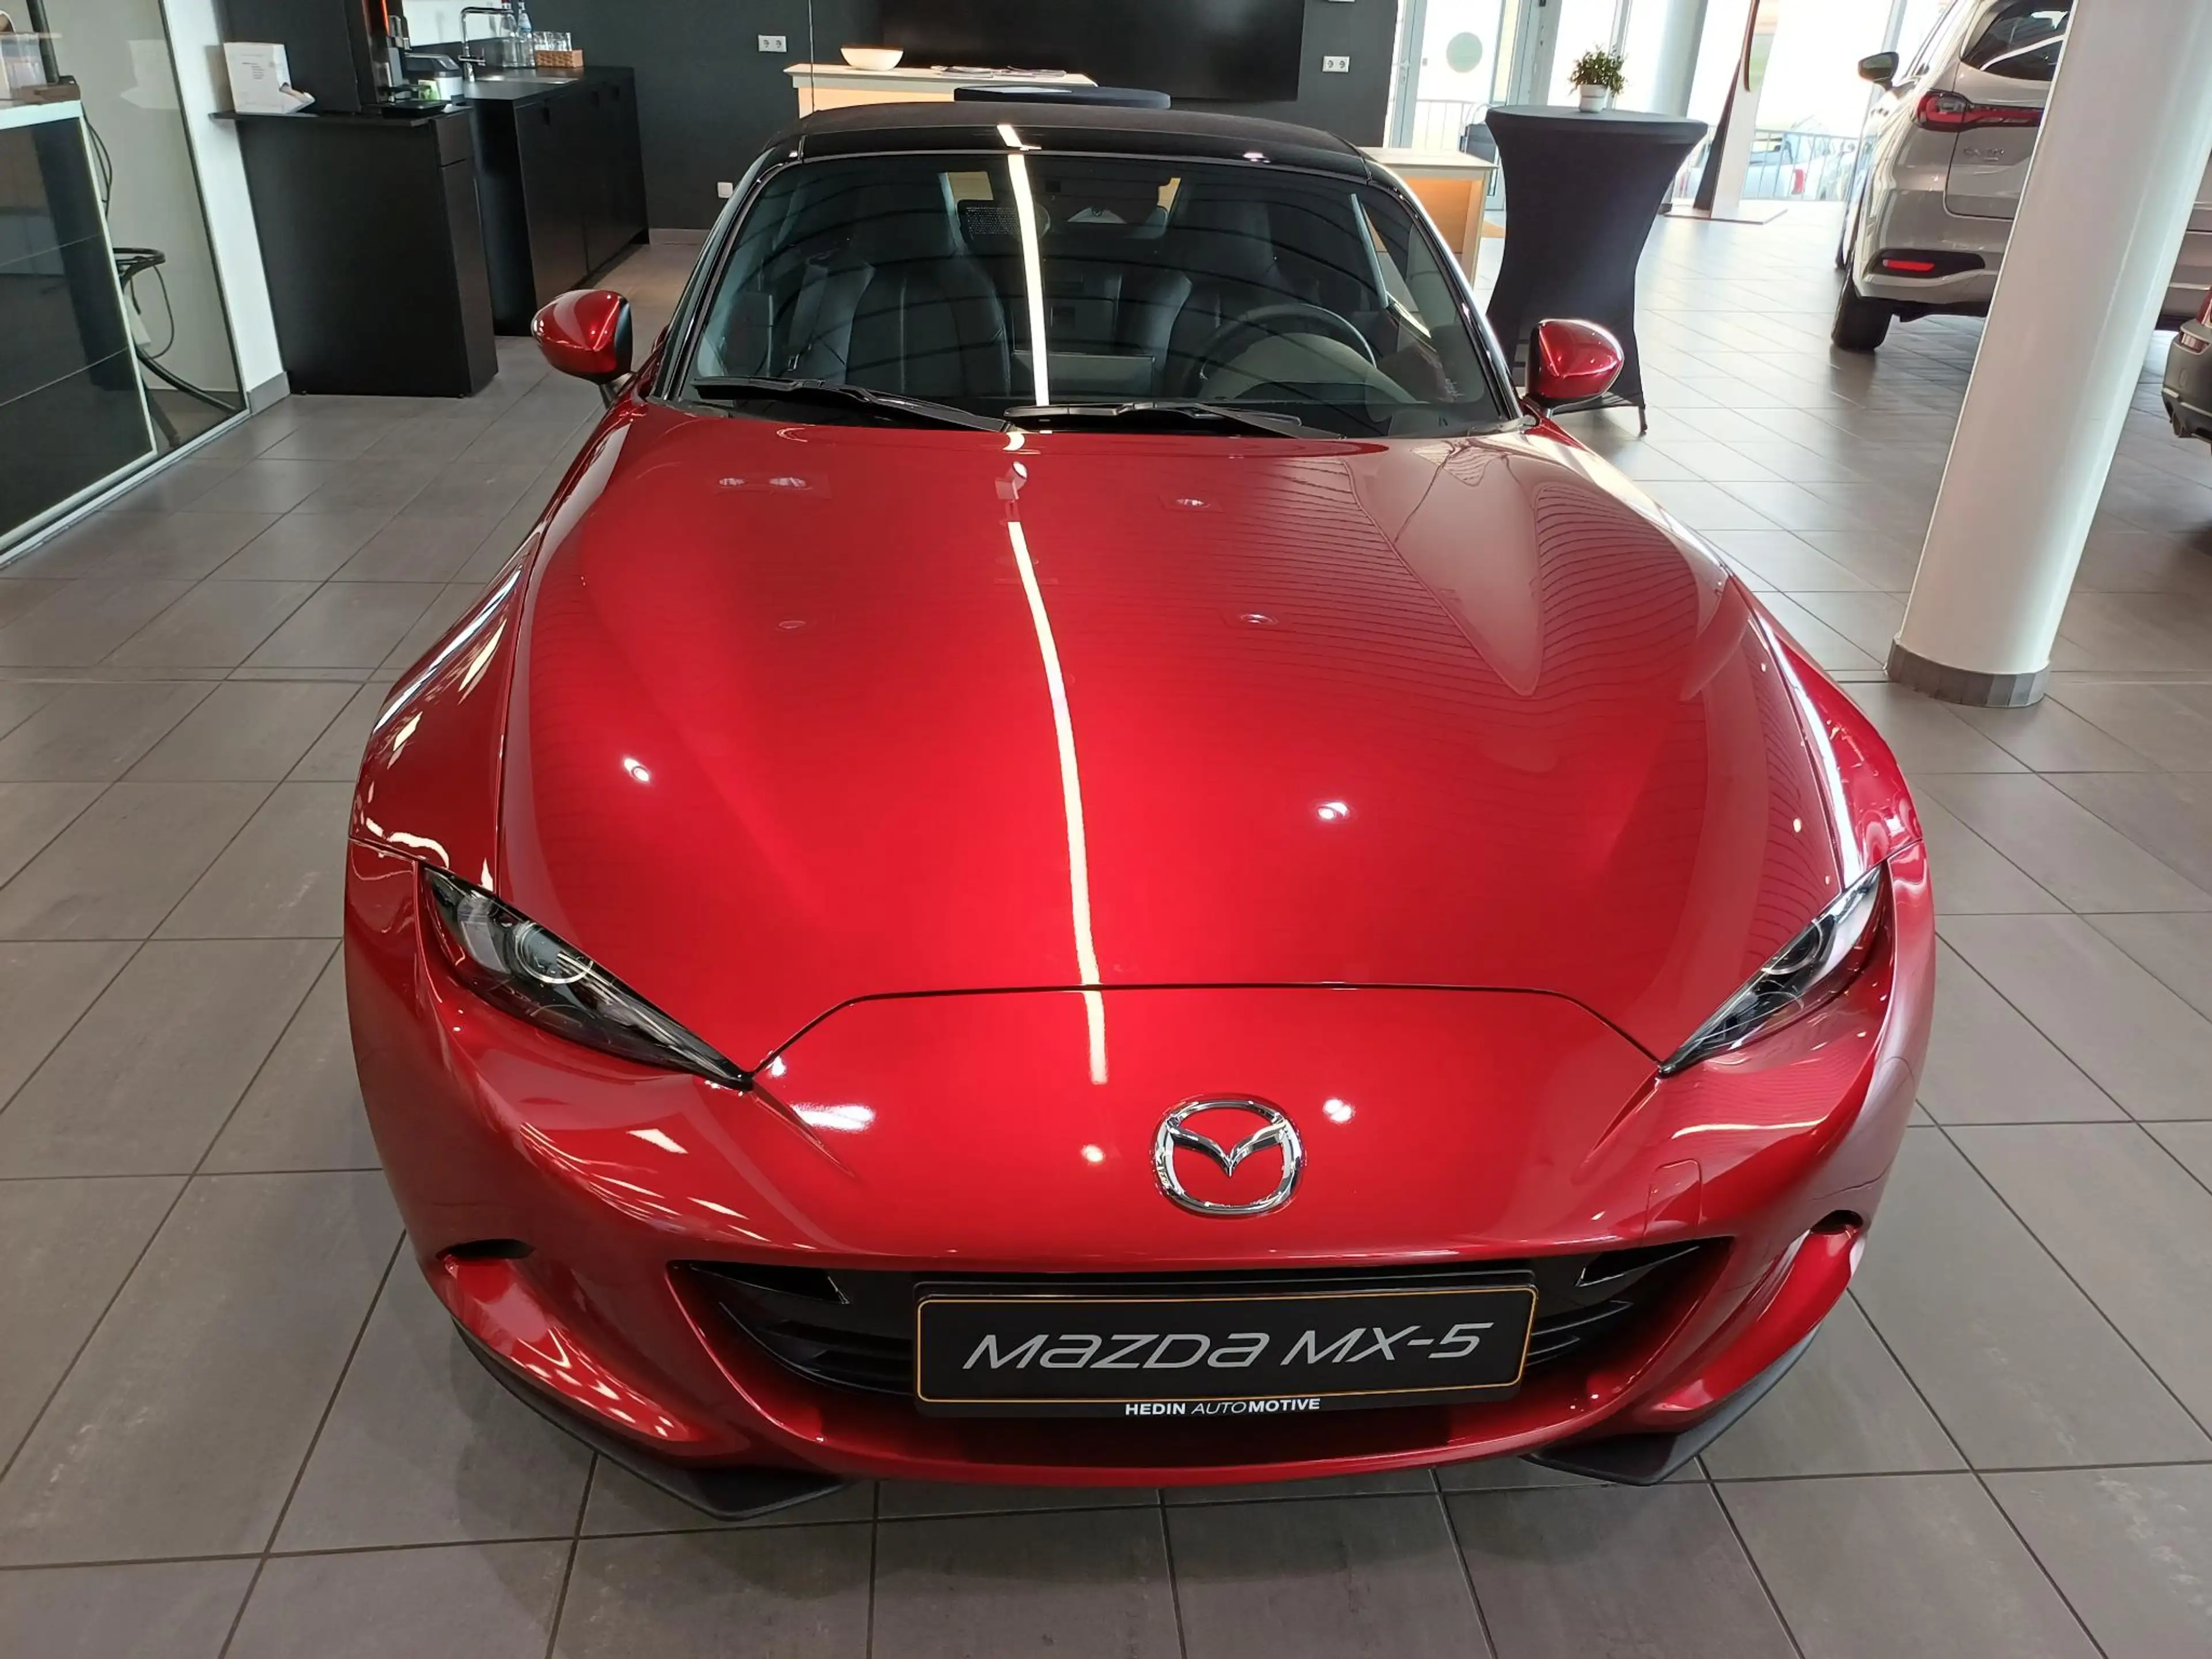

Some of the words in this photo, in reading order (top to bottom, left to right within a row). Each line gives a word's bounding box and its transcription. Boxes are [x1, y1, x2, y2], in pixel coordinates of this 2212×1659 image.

[1280, 1322, 1494, 1366] MX-5
[1125, 1403, 1185, 1415] HEDIN
[1191, 1398, 1321, 1415] AUTOMOTIVE
